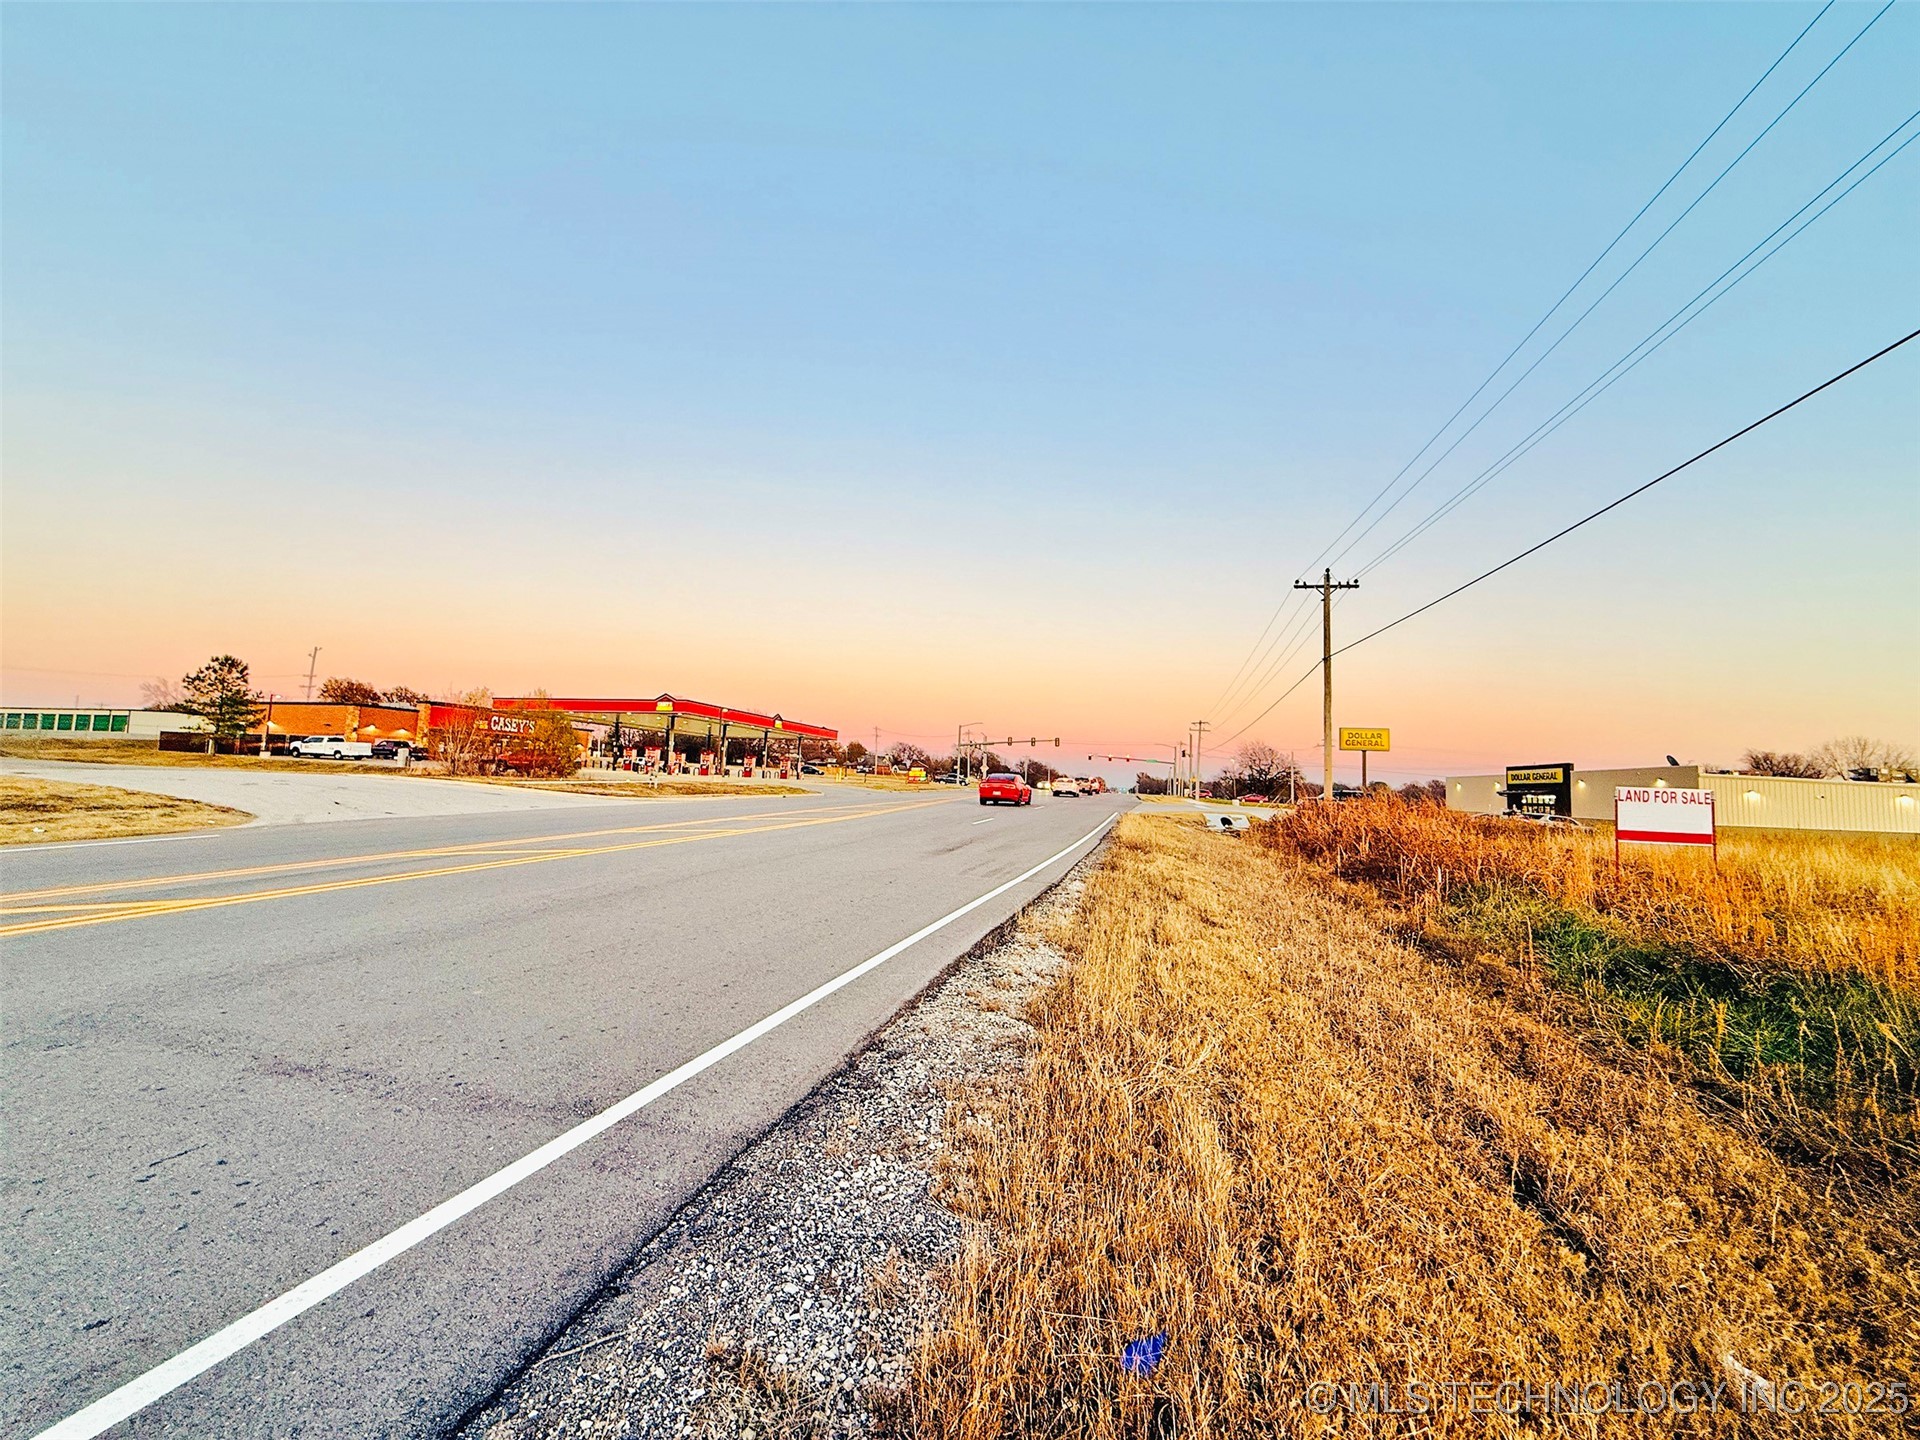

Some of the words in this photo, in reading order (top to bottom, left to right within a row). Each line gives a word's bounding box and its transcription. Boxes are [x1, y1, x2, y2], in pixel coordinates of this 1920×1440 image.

[491, 716, 535, 733] CASEY'S
[1347, 732, 1383, 740] DOLLAR
[1345, 739, 1385, 747] GENERAL
[1510, 773, 1532, 781] DOLLAR
[1532, 771, 1558, 781] GENERAL
[1618, 790, 1650, 803] LAND
[1654, 791, 1678, 804] FOR
[1681, 792, 1711, 805] SALE
